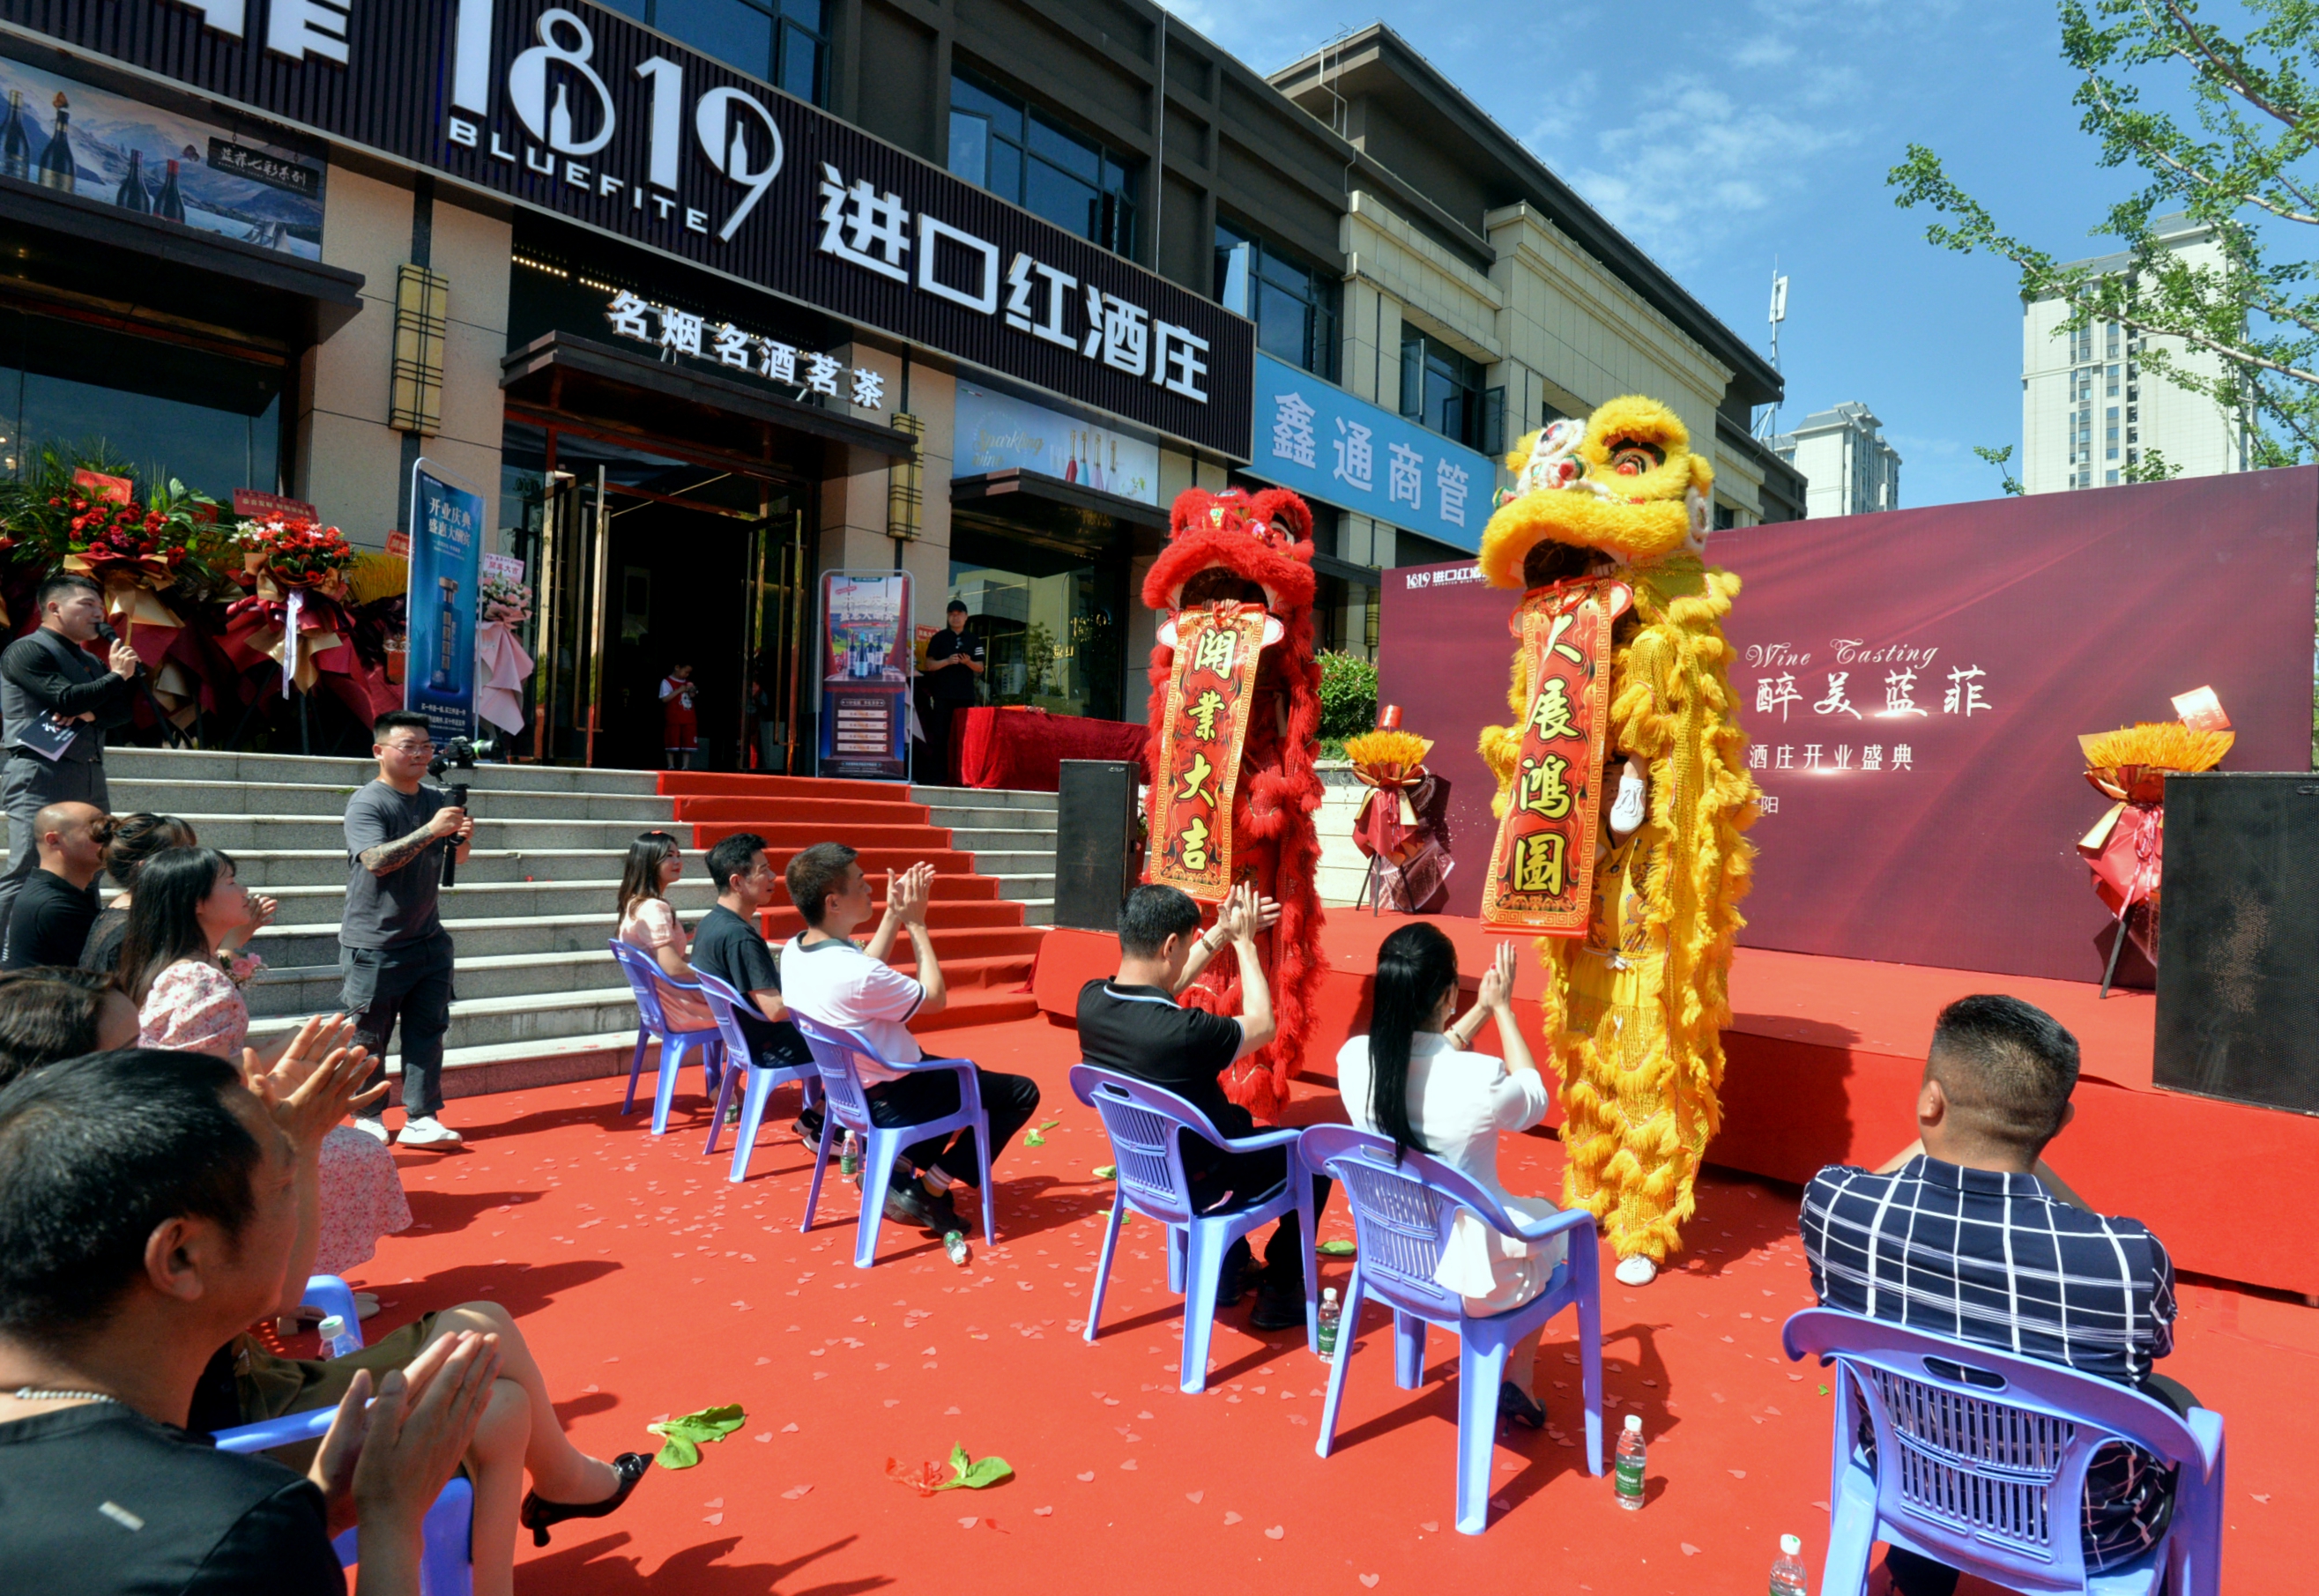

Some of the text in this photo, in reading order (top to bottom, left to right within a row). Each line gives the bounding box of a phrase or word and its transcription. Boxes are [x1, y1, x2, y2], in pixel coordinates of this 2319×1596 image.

[448, 114, 708, 236] BLUEFITE
[815, 162, 1210, 405] 进口红酒庄
[606, 288, 885, 412] 名烟名酒茗茶
[972, 429, 1044, 457] Sparkling
[1273, 391, 1469, 528] 鑫通商管
[971, 450, 1005, 470] wine
[428, 497, 472, 531] 开业庆典
[1406, 572, 1431, 589] 1819
[1433, 567, 1489, 583] 进口红酒
[1745, 638, 1939, 670] Wine Tasting
[1756, 664, 1992, 724] 醉美蓝菲
[1749, 744, 1914, 771] 酒庄开业盛典
